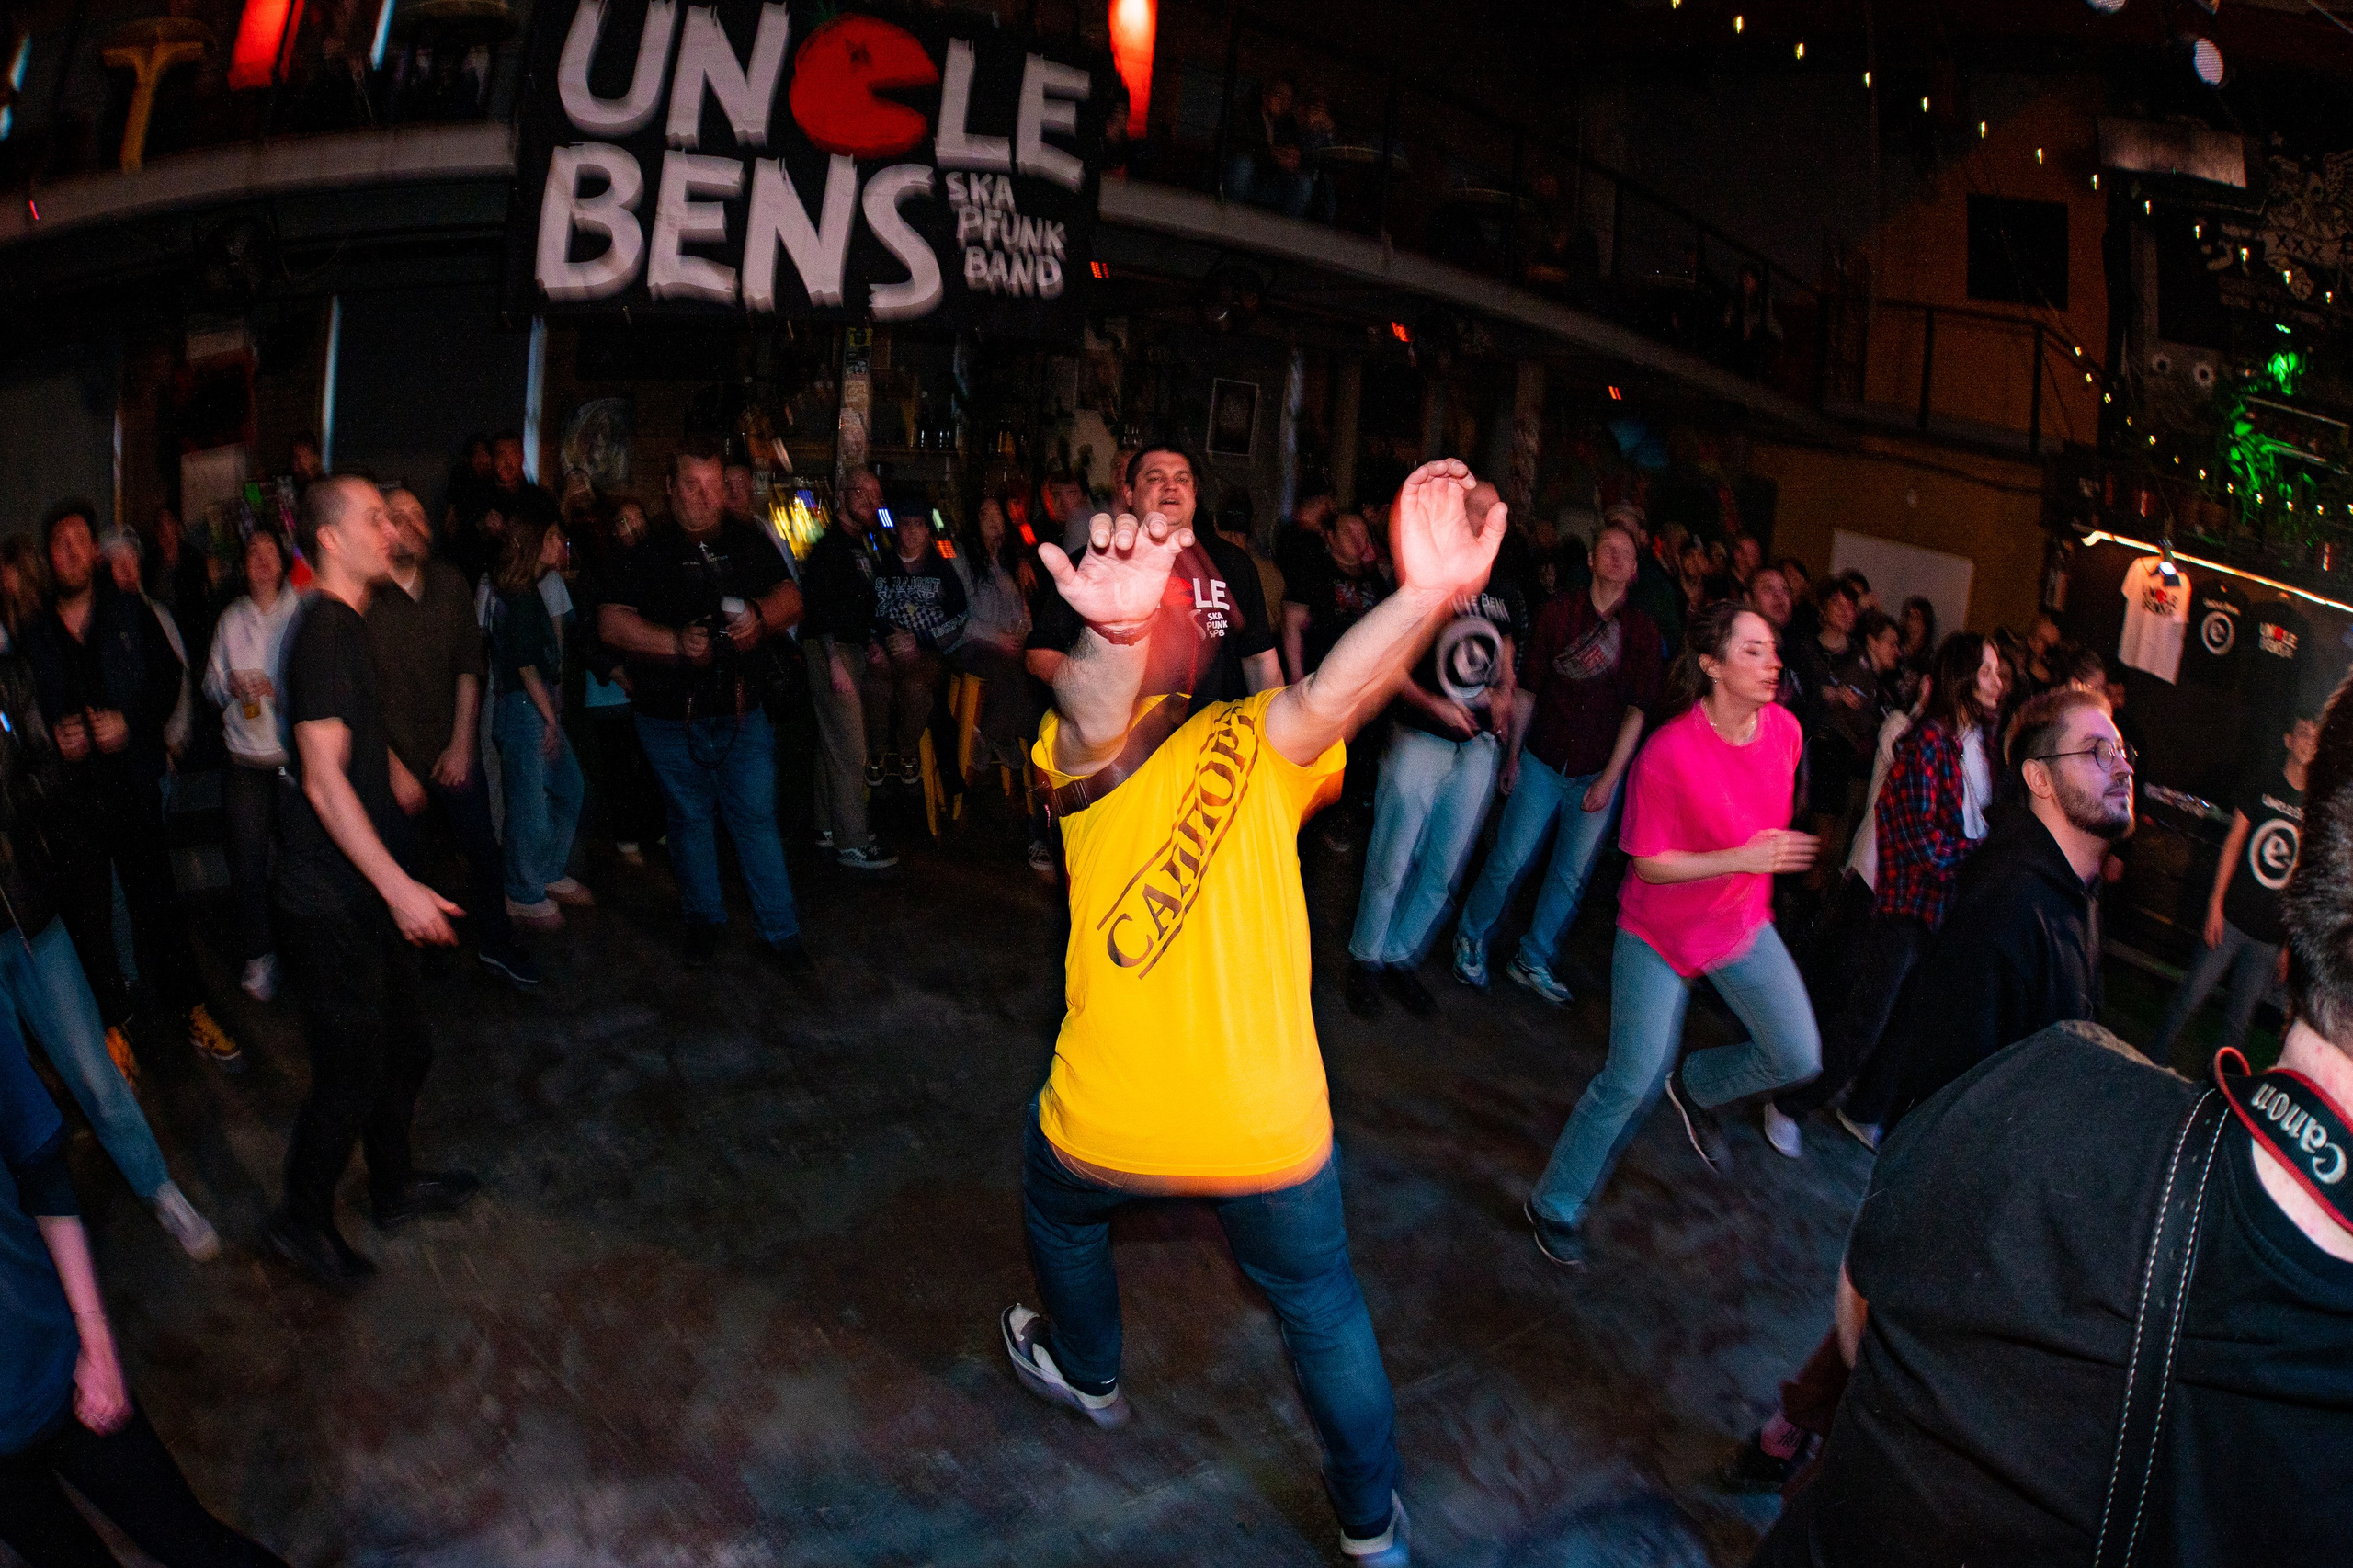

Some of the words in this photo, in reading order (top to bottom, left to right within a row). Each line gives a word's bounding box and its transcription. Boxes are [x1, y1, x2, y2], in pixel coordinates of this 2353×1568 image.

[945, 171, 1017, 213] SKA
[536, 141, 944, 322] BENS
[956, 205, 1067, 263] PFUNK
[963, 245, 1065, 299] BAND
[1206, 619, 1229, 631] PUNK
[1207, 611, 1224, 621] SKA
[1209, 629, 1226, 639] SPB
[2251, 1082, 2347, 1185] Canon
